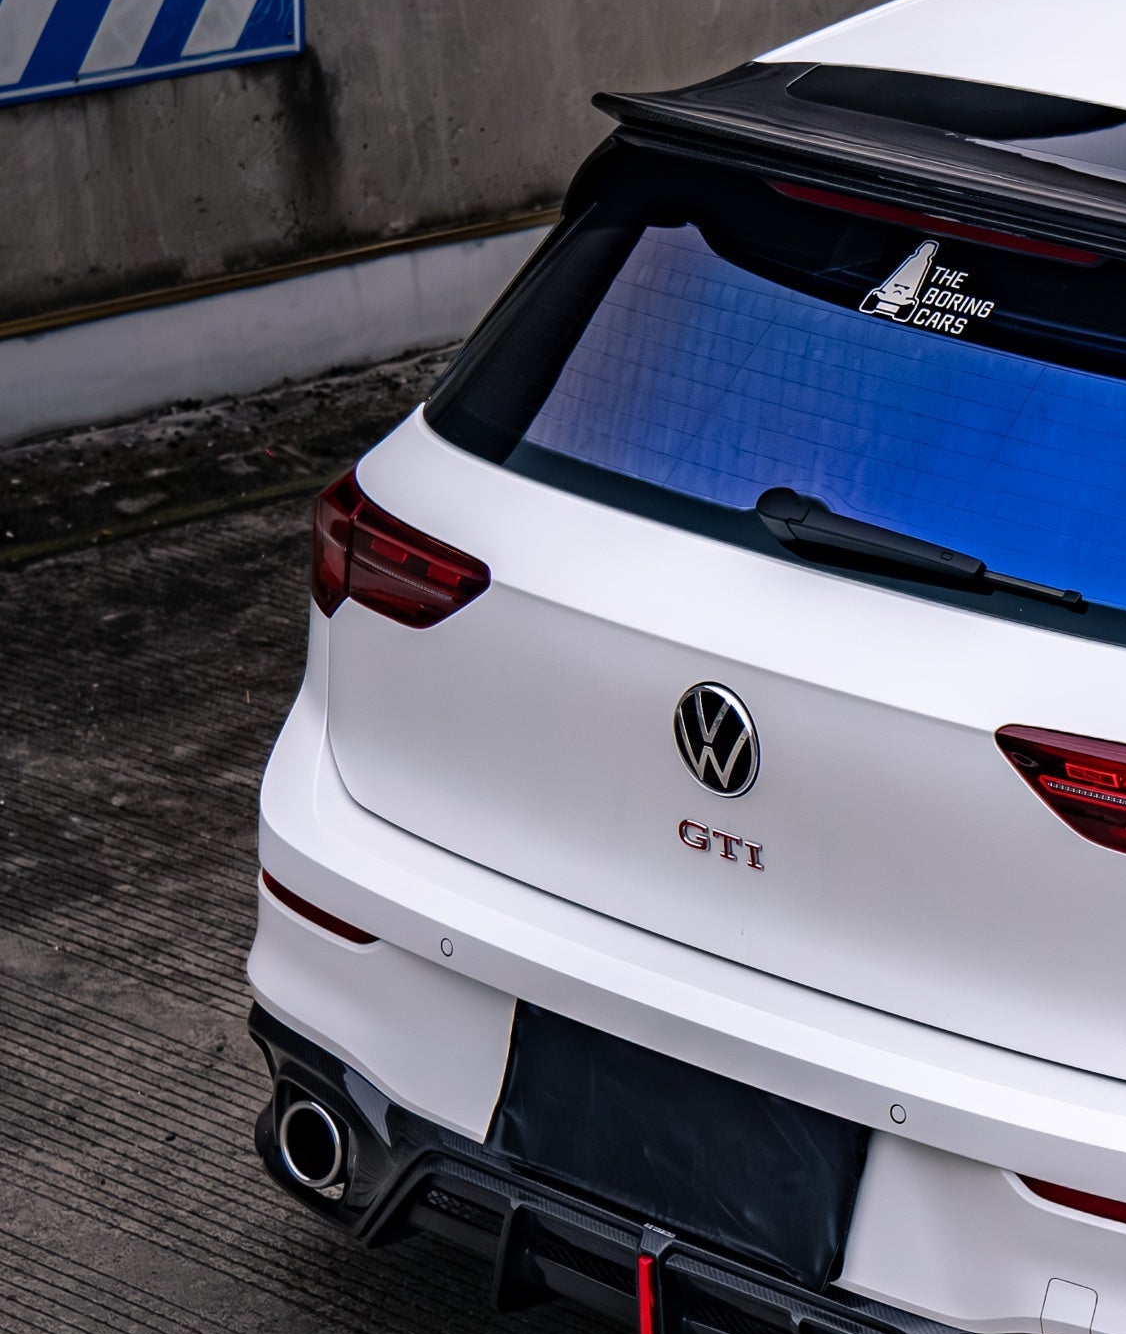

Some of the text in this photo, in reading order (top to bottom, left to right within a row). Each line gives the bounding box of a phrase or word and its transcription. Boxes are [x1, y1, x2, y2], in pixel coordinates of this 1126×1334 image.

[930, 265, 969, 289] THE
[922, 287, 995, 318] BORING
[913, 308, 968, 335] CARS
[678, 819, 765, 871] GTI
